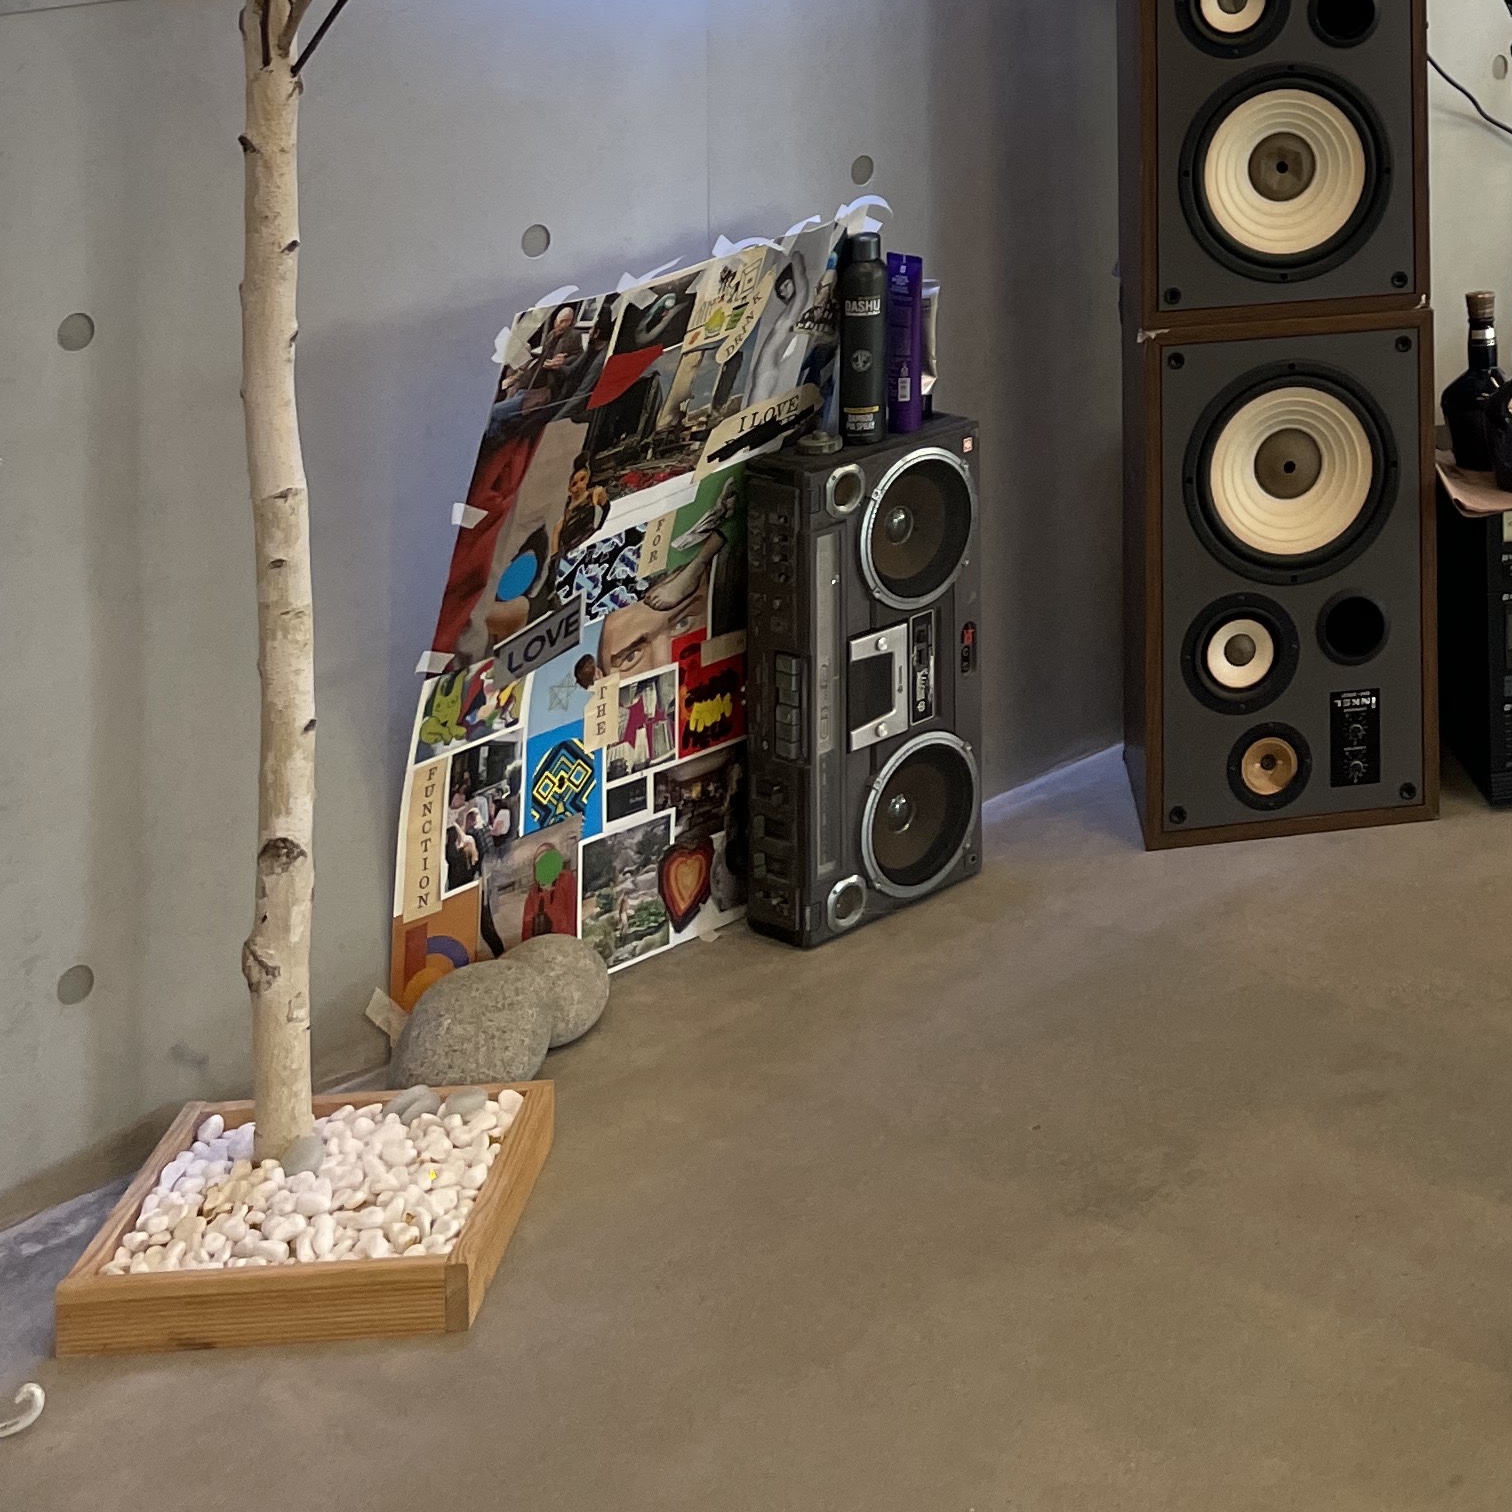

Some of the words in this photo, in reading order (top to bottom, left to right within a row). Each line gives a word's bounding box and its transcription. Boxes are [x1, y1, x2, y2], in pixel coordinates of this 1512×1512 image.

[844, 298, 881, 313] DASHU
[738, 415, 748, 434] I
[749, 395, 799, 430] LOVE
[648, 518, 665, 564] FOR
[508, 610, 579, 674] LOVE
[596, 685, 608, 736] THE
[417, 765, 438, 909] FUNCTION
